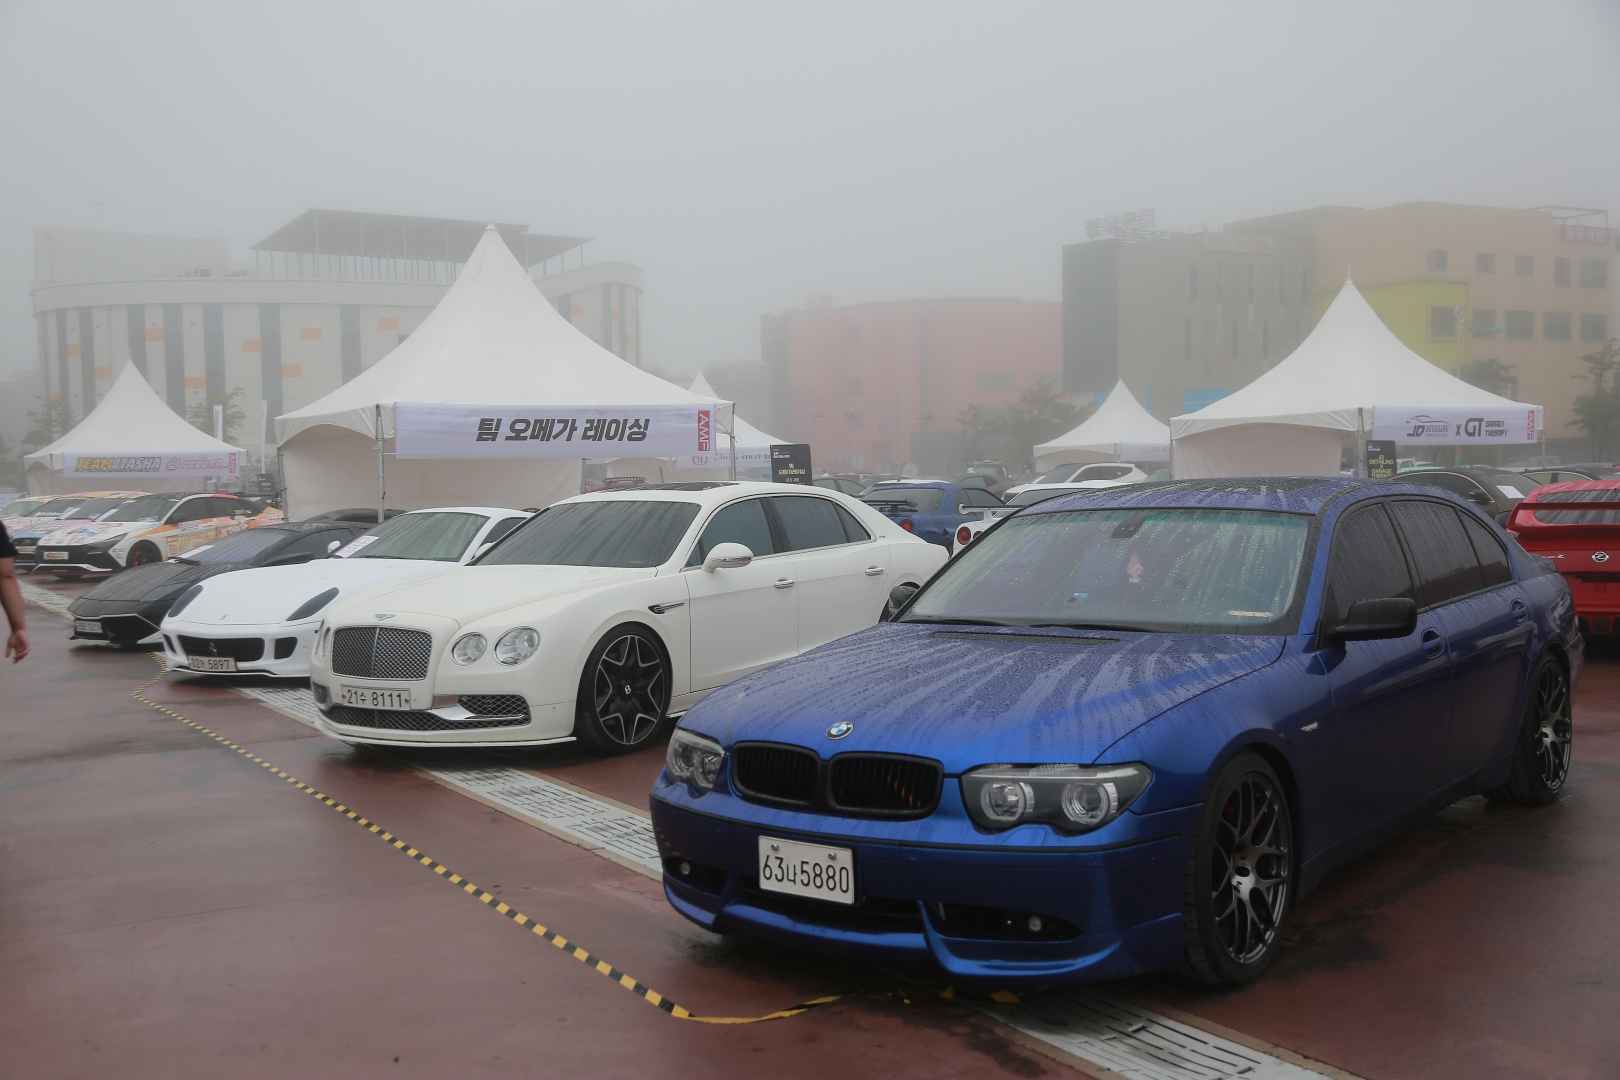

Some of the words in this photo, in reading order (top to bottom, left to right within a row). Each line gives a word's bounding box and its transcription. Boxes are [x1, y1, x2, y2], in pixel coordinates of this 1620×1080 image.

[475, 418, 500, 442] 팀
[504, 418, 578, 442] 오메가
[581, 418, 650, 442] 레이싱
[1465, 418, 1485, 437] GT
[346, 689, 369, 705] 21수
[372, 691, 402, 707] 8111
[762, 854, 850, 894] 63나5880
